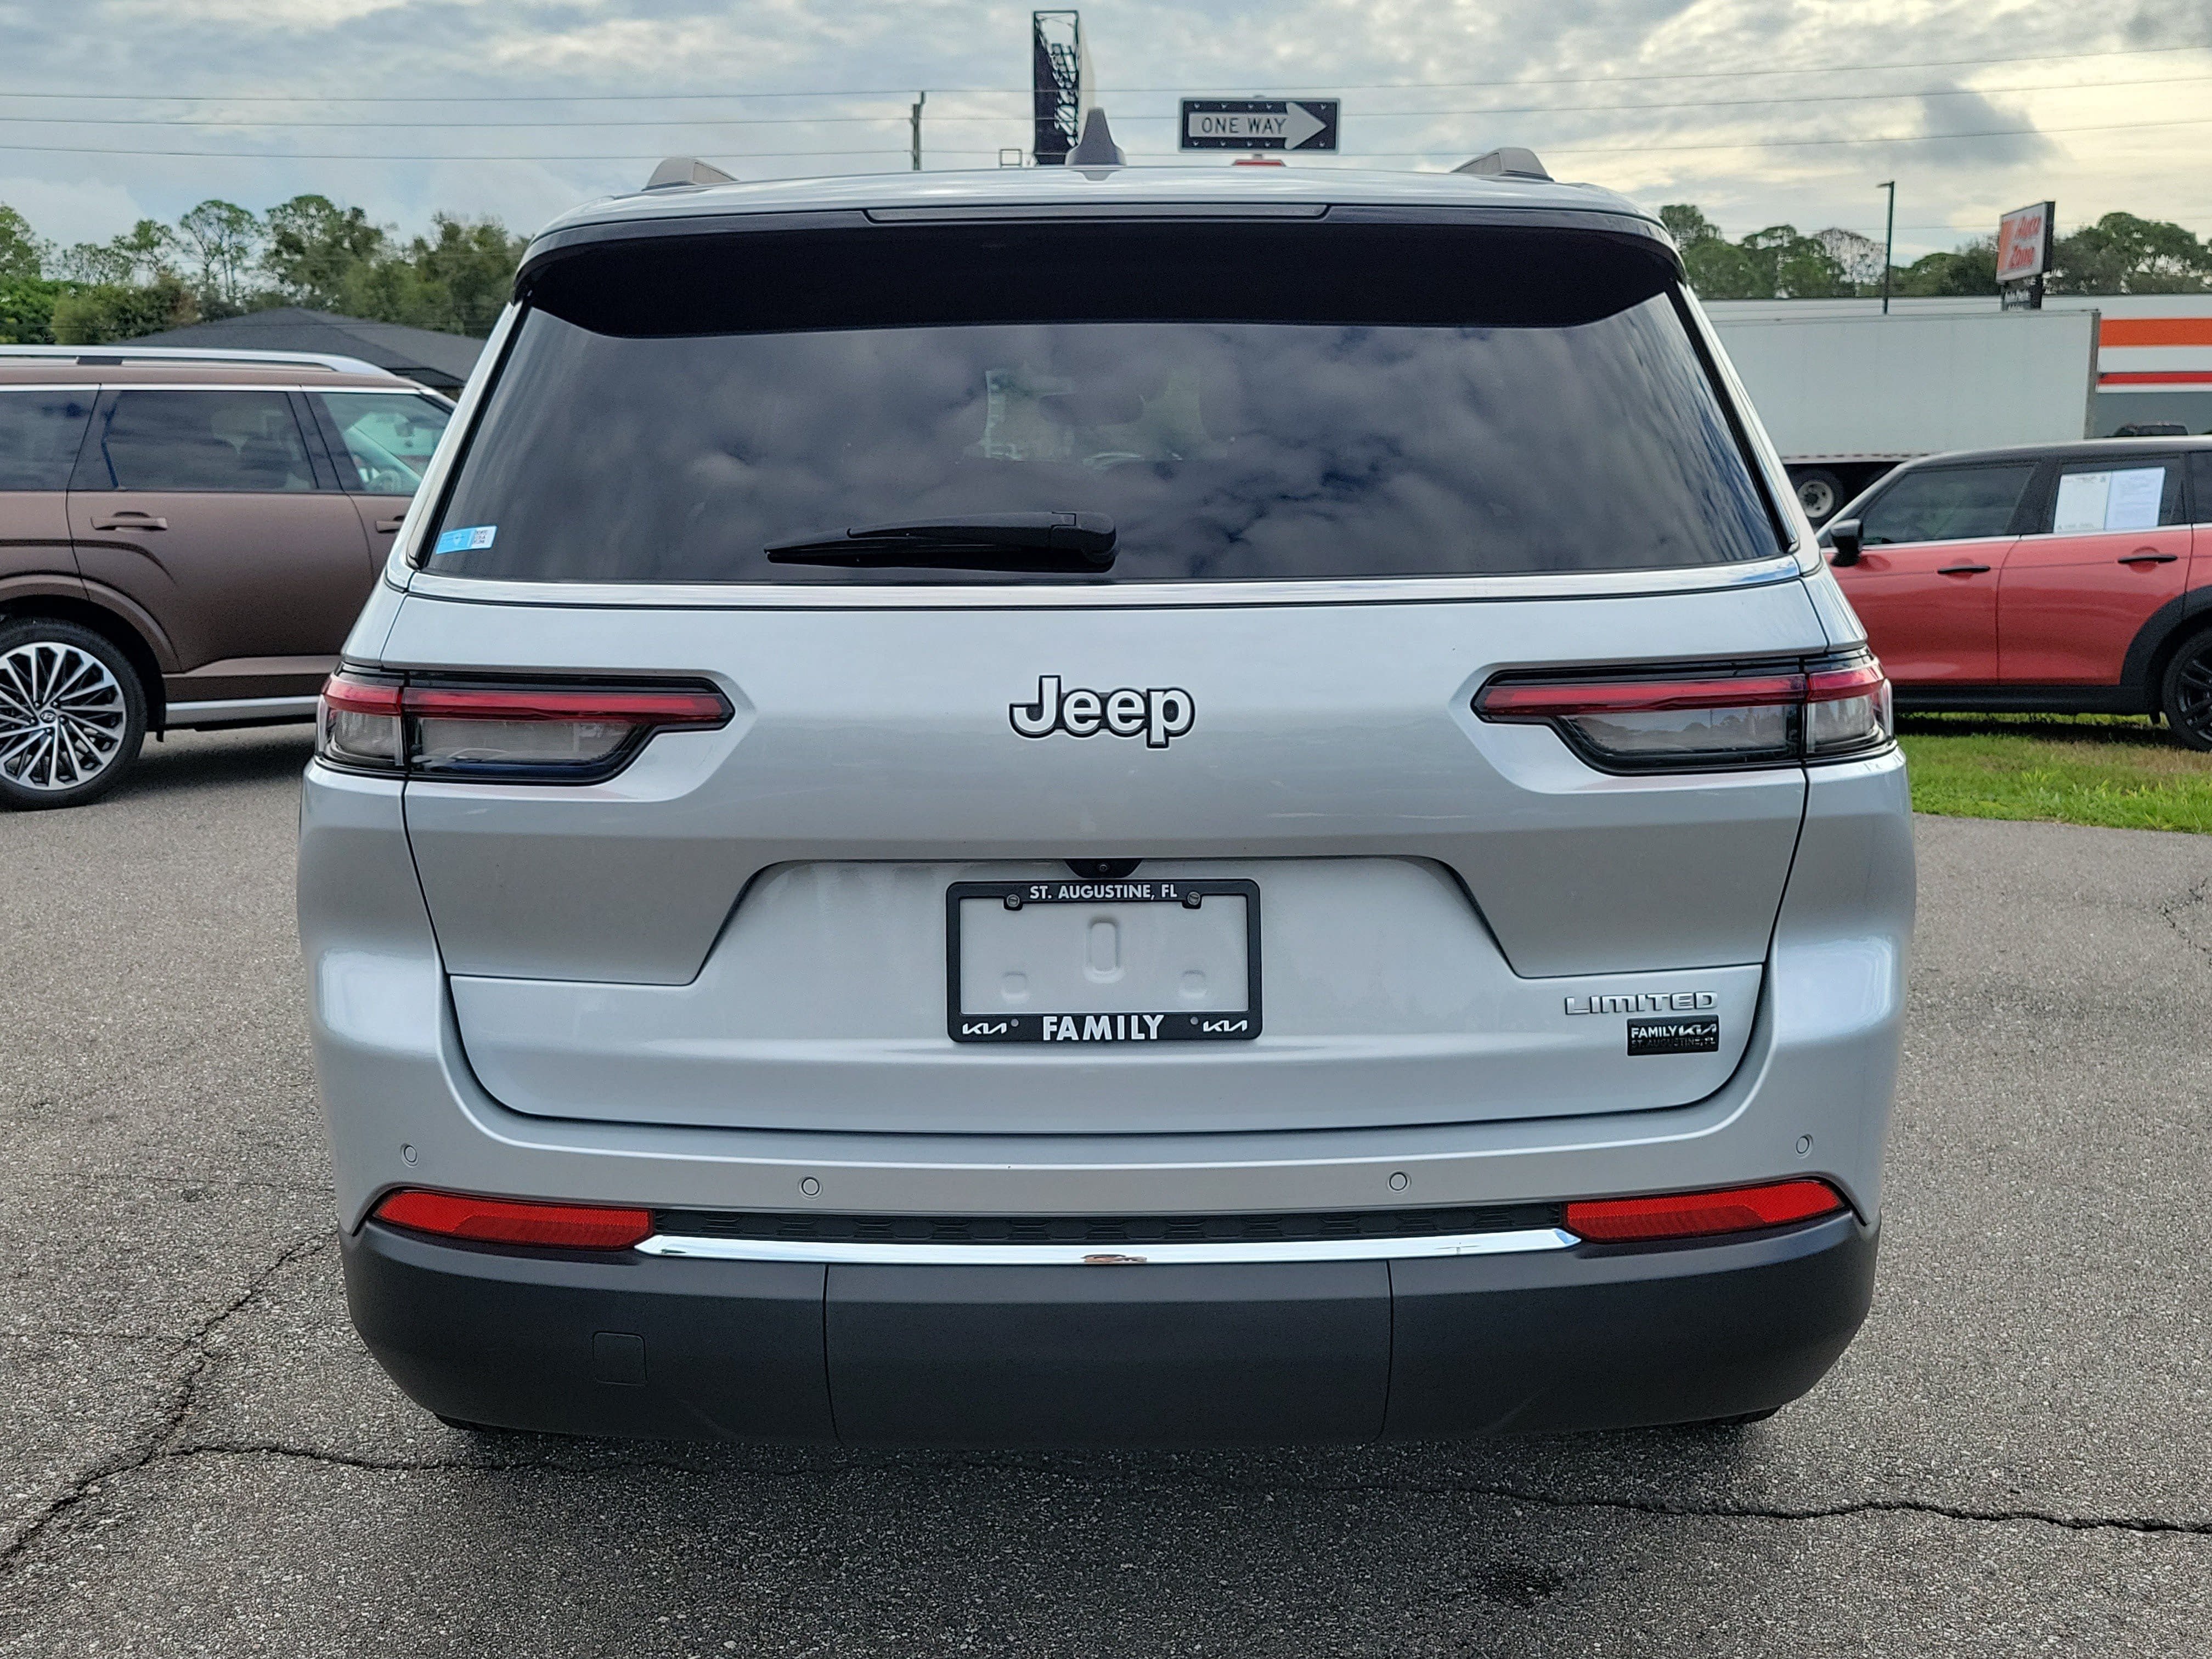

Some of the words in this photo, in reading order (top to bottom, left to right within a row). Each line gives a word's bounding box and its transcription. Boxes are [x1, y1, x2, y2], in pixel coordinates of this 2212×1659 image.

[1200, 117, 1239, 134] ONE
[1247, 116, 1287, 134] WAY
[1009, 675, 1195, 748] Jeep
[1030, 885, 1051, 899] ST.
[1058, 884, 1154, 900] AUGUSTINE,
[1161, 884, 1177, 898] FL
[1565, 991, 1718, 1014] LIMITED
[1043, 1015, 1164, 1041] FAMILY
[1631, 1025, 1677, 1039] FAMILY
